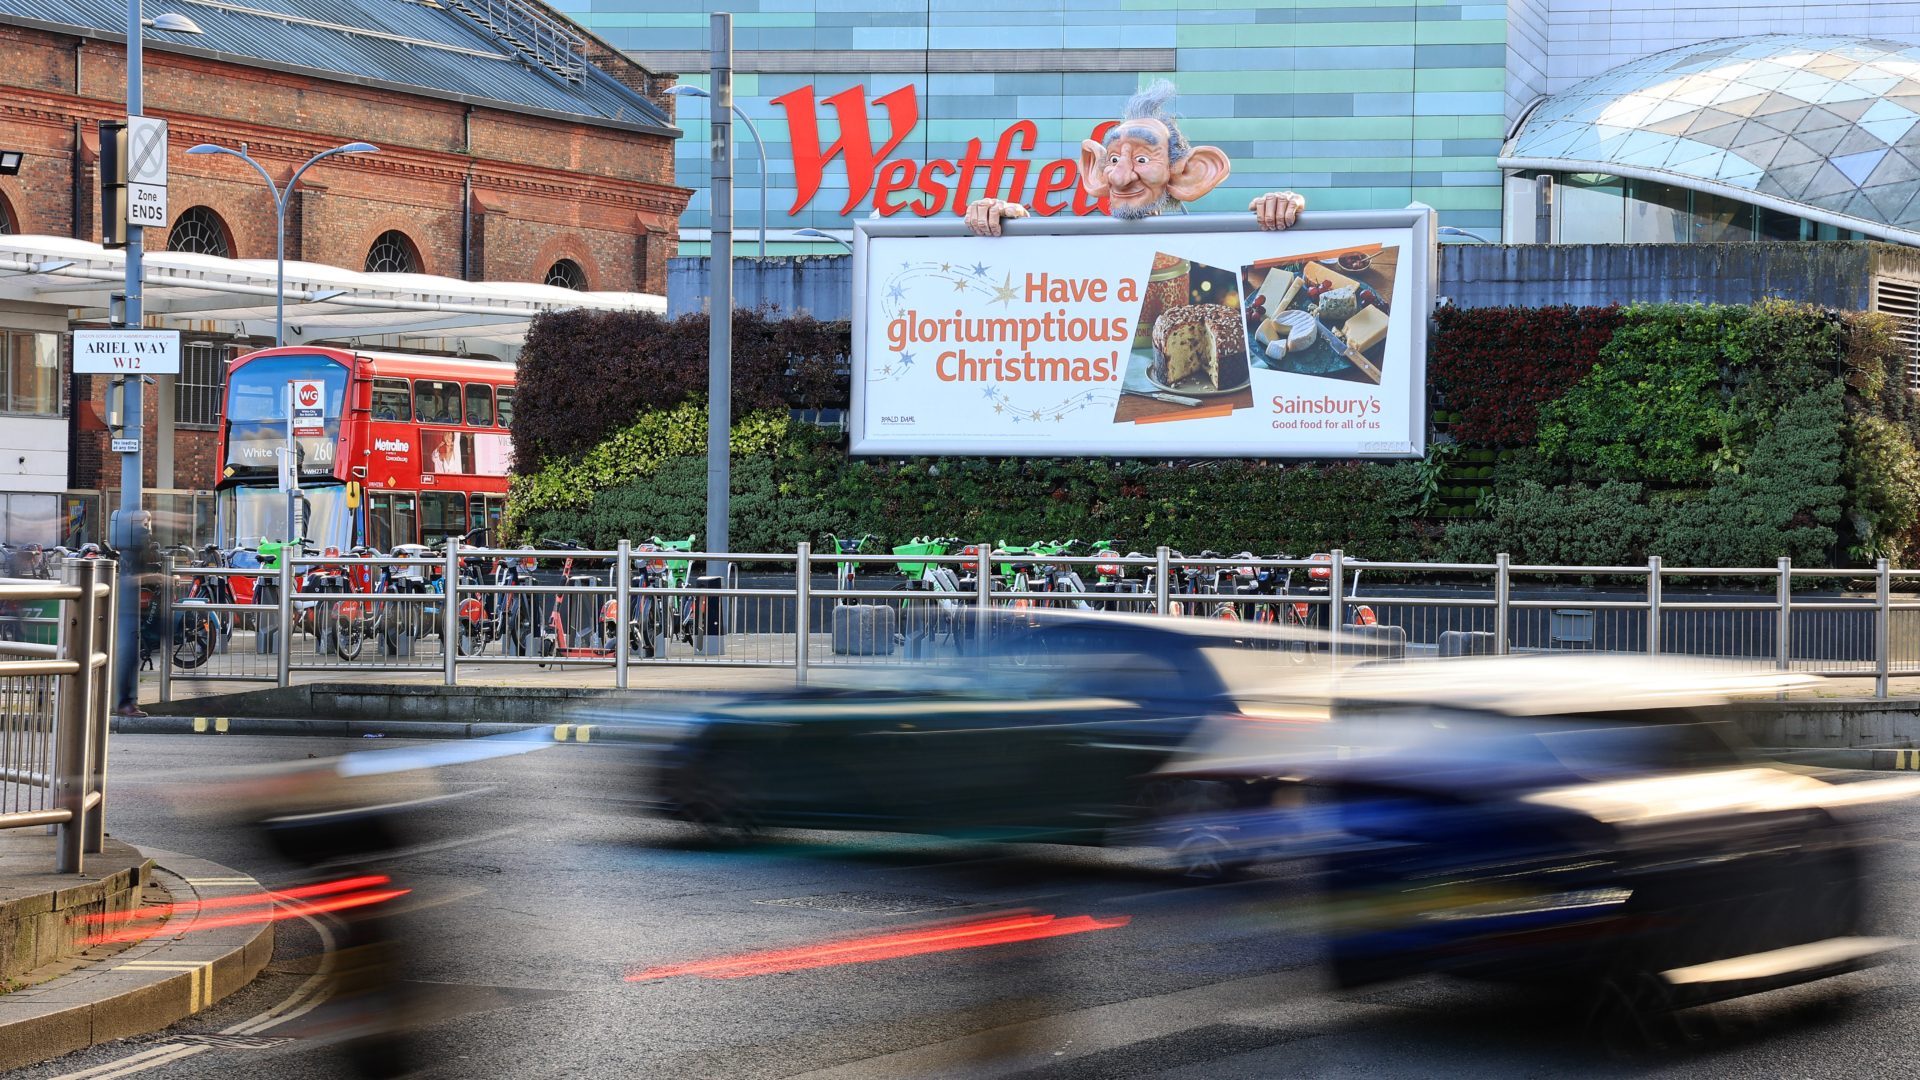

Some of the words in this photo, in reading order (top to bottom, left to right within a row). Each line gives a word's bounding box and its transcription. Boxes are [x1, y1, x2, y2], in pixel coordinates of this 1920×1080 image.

[138, 189, 157, 201] Zone
[133, 204, 163, 220] ENDS
[1025, 272, 1108, 303] Have
[1117, 278, 1138, 302] a
[887, 309, 1129, 351] gloriumptious
[85, 342, 130, 354] ARIEL
[134, 342, 168, 354] WAY
[113, 357, 141, 369] W12
[936, 349, 1118, 382] Christmas!
[300, 391, 318, 400] WG
[1272, 395, 1381, 417] Sainsbury's
[1272, 420, 1298, 429] Good
[1300, 420, 1322, 429] food
[1325, 420, 1339, 429] for
[1341, 420, 1353, 429] all
[1356, 420, 1367, 429] of
[1368, 421, 1380, 429] us
[313, 442, 333, 461] 260
[374, 438, 409, 452] Metroline
[1365, 442, 1405, 452] OCEAN
[243, 447, 272, 458] White
[146, 601, 158, 624] forest
